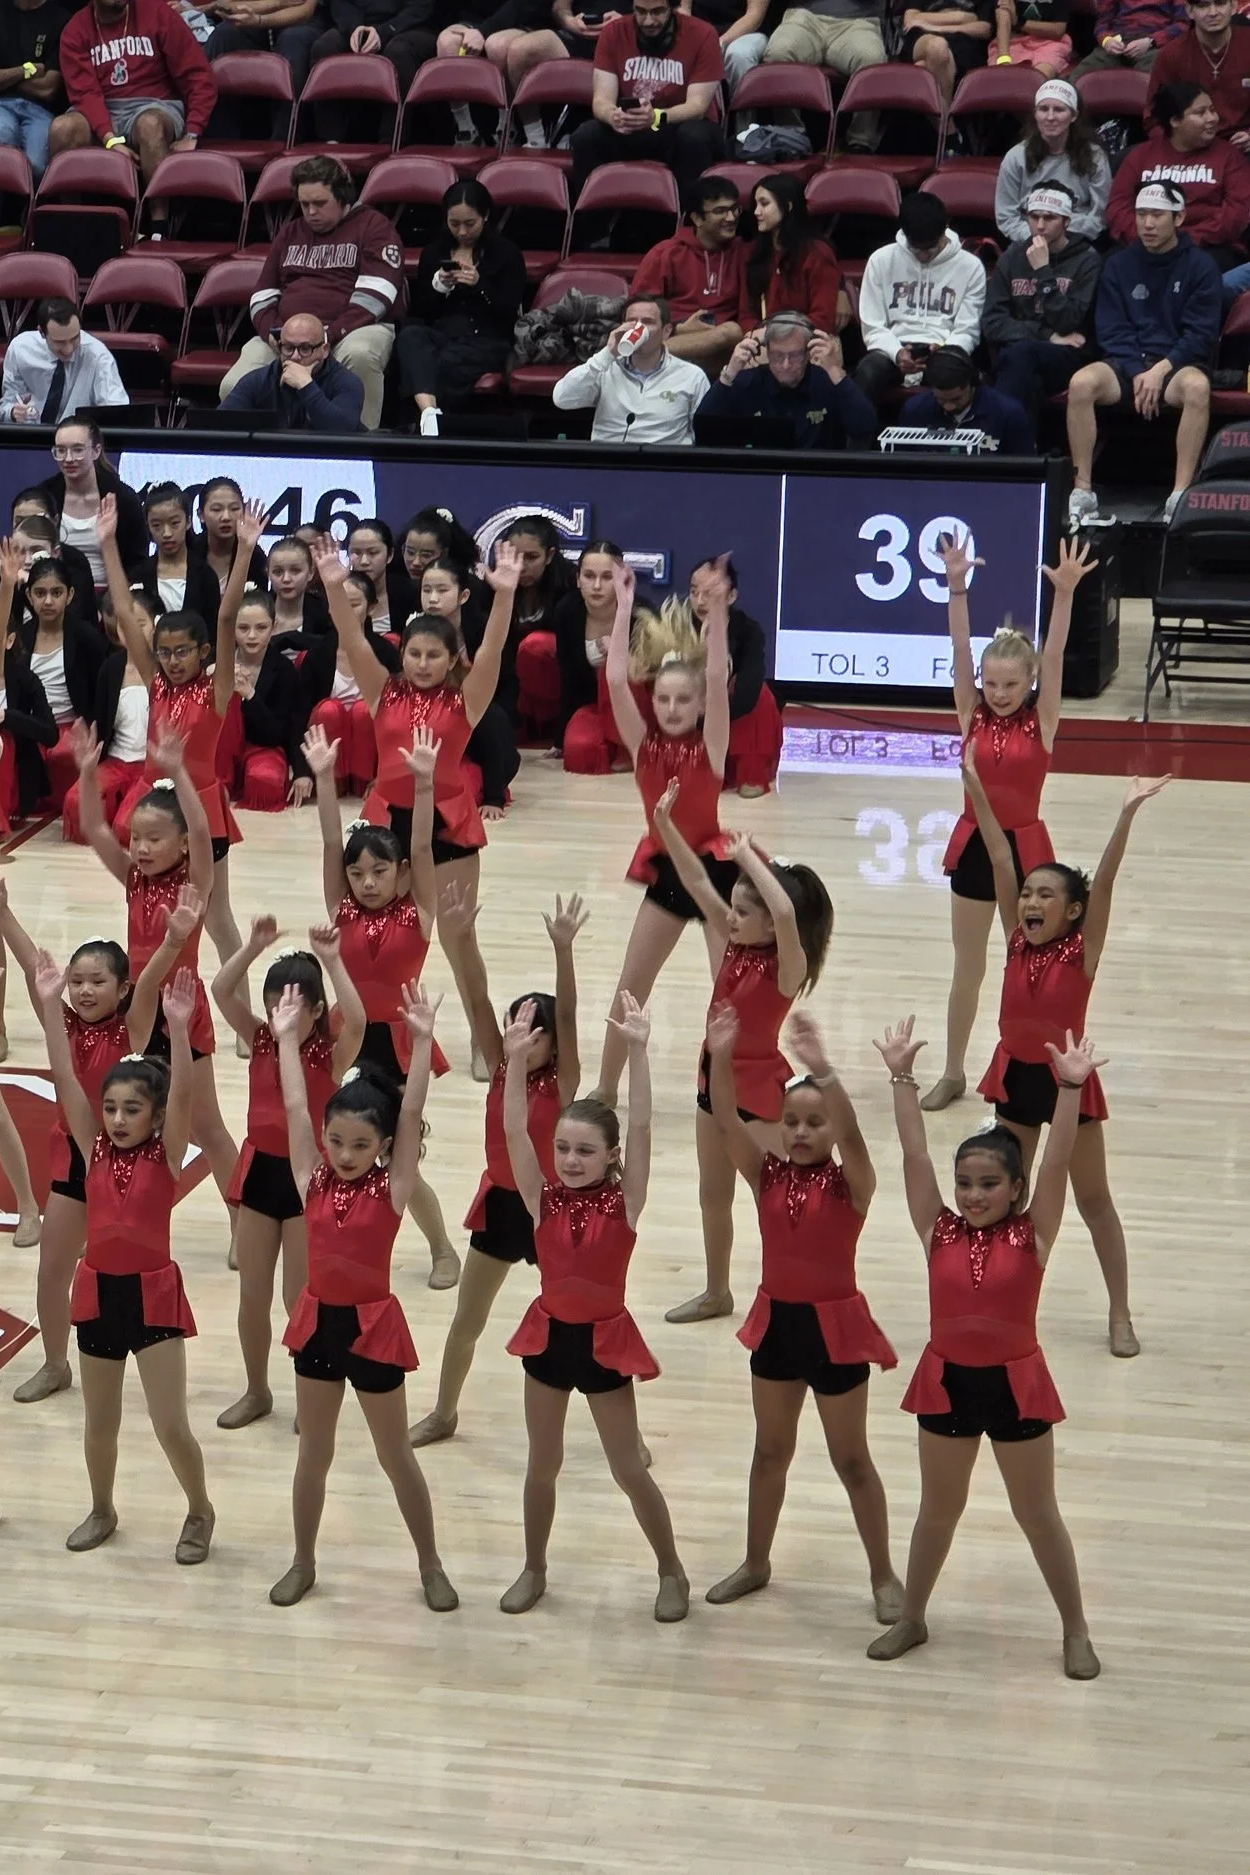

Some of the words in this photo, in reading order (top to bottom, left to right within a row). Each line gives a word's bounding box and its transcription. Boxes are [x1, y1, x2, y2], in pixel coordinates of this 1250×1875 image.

[855, 513, 976, 604] 39
[811, 652, 866, 676] TOL
[875, 655, 891, 677] 3
